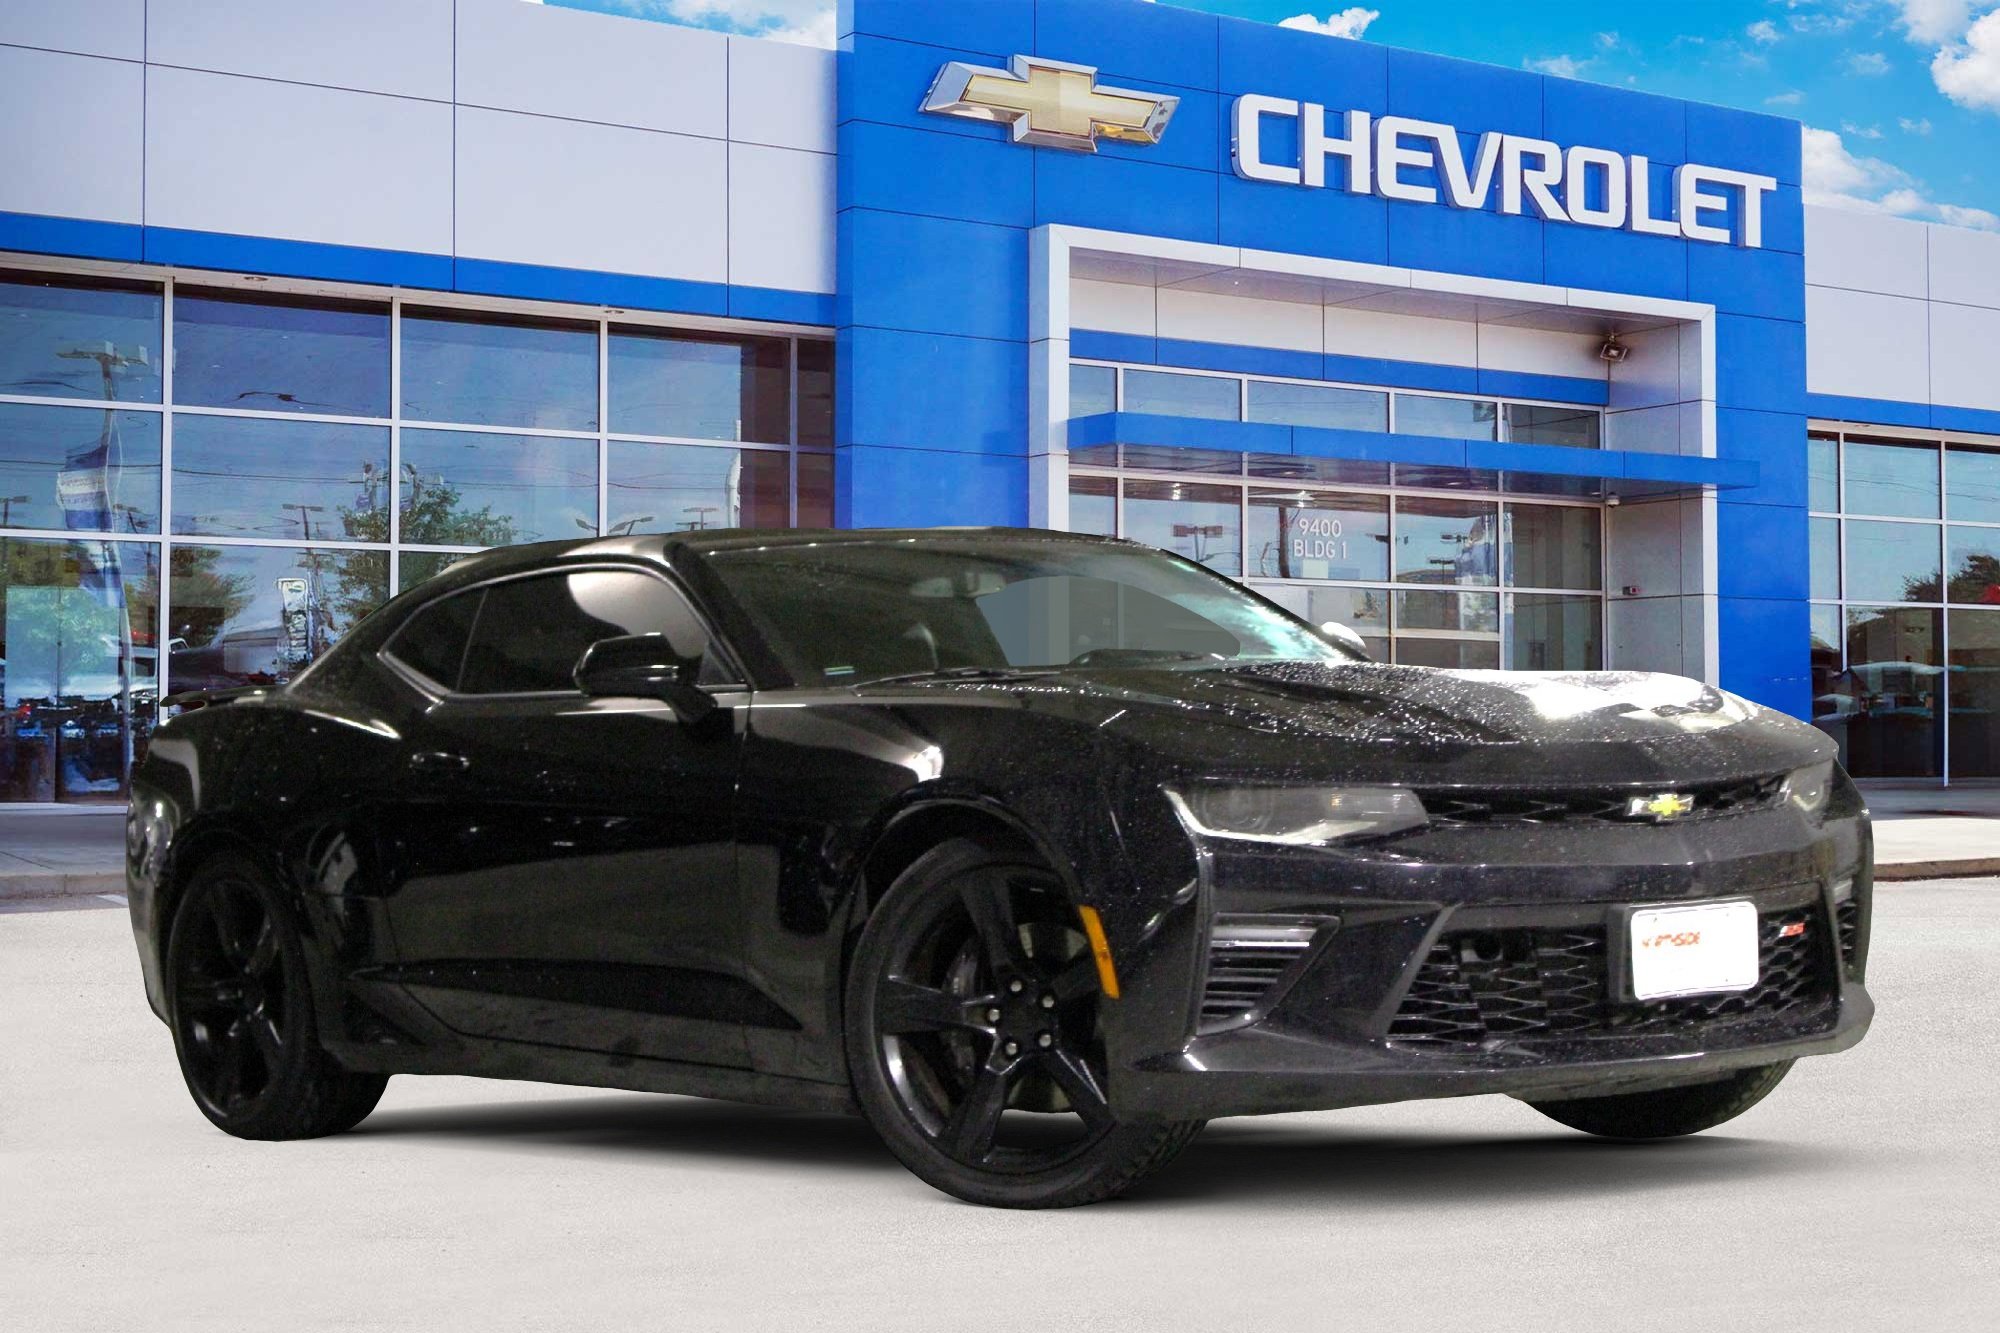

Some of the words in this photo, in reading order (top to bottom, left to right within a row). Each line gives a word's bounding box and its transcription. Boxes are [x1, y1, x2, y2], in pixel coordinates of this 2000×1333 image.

[1231, 93, 1777, 249] CHEVROLET
[1299, 518, 1342, 537] 9400
[1294, 539, 1336, 559] BLDG
[1341, 541, 1348, 559] 1
